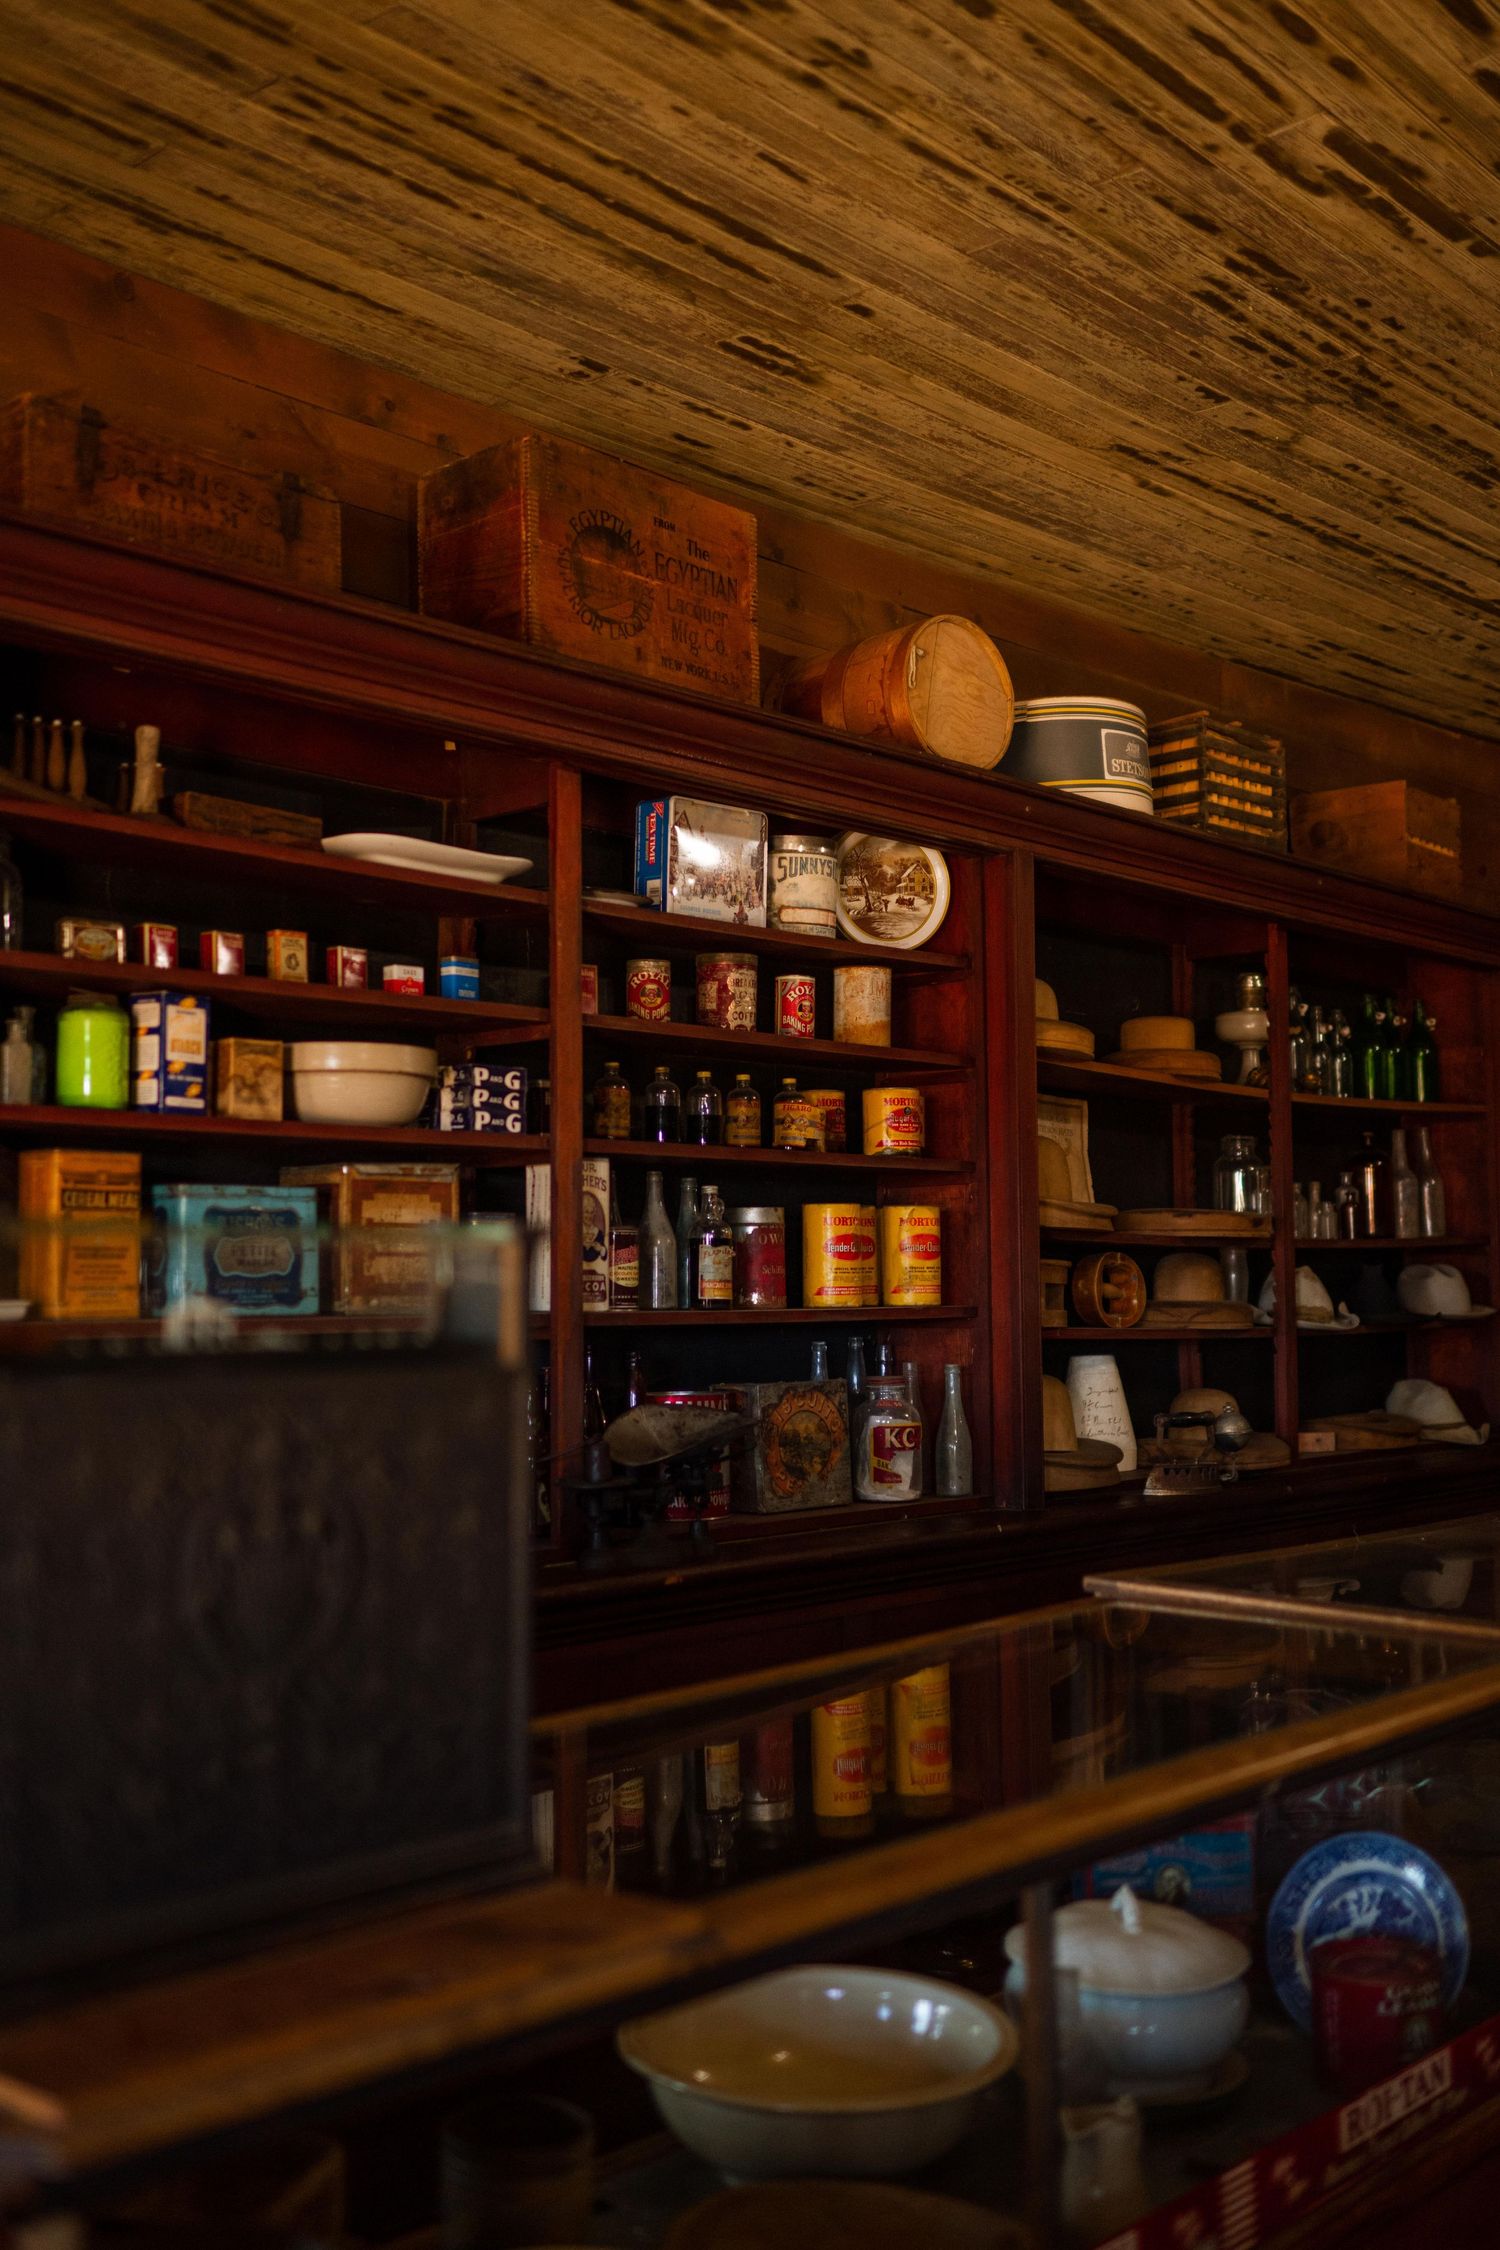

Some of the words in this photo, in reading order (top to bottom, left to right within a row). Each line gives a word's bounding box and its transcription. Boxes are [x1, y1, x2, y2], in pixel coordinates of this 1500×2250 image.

[568, 509, 645, 557] EGYPTIAN
[654, 516, 676, 533] FROM
[687, 538, 710, 562] The
[655, 551, 738, 605] EGYPTIAN
[667, 588, 728, 628] Lacquer
[661, 655, 682, 671] NEW
[649, 812, 657, 835] TEA
[648, 837, 656, 865] TIME
[630, 971, 671, 991] ROYAL
[732, 1011, 756, 1021] COFF
[782, 1015, 805, 1033] BAKING
[473, 1066, 490, 1087] P
[504, 1070, 521, 1091] G
[472, 1088, 490, 1108] P
[503, 1092, 520, 1111] G
[783, 1104, 812, 1113] FIGARO
[884, 1097, 920, 1106] MORTO
[474, 1110, 491, 1131] P
[505, 1113, 522, 1133] G
[582, 1161, 597, 1173] UR
[582, 1174, 607, 1192] HER'S
[898, 1216, 938, 1227] MORTO
[884, 1427, 916, 1449] KC
